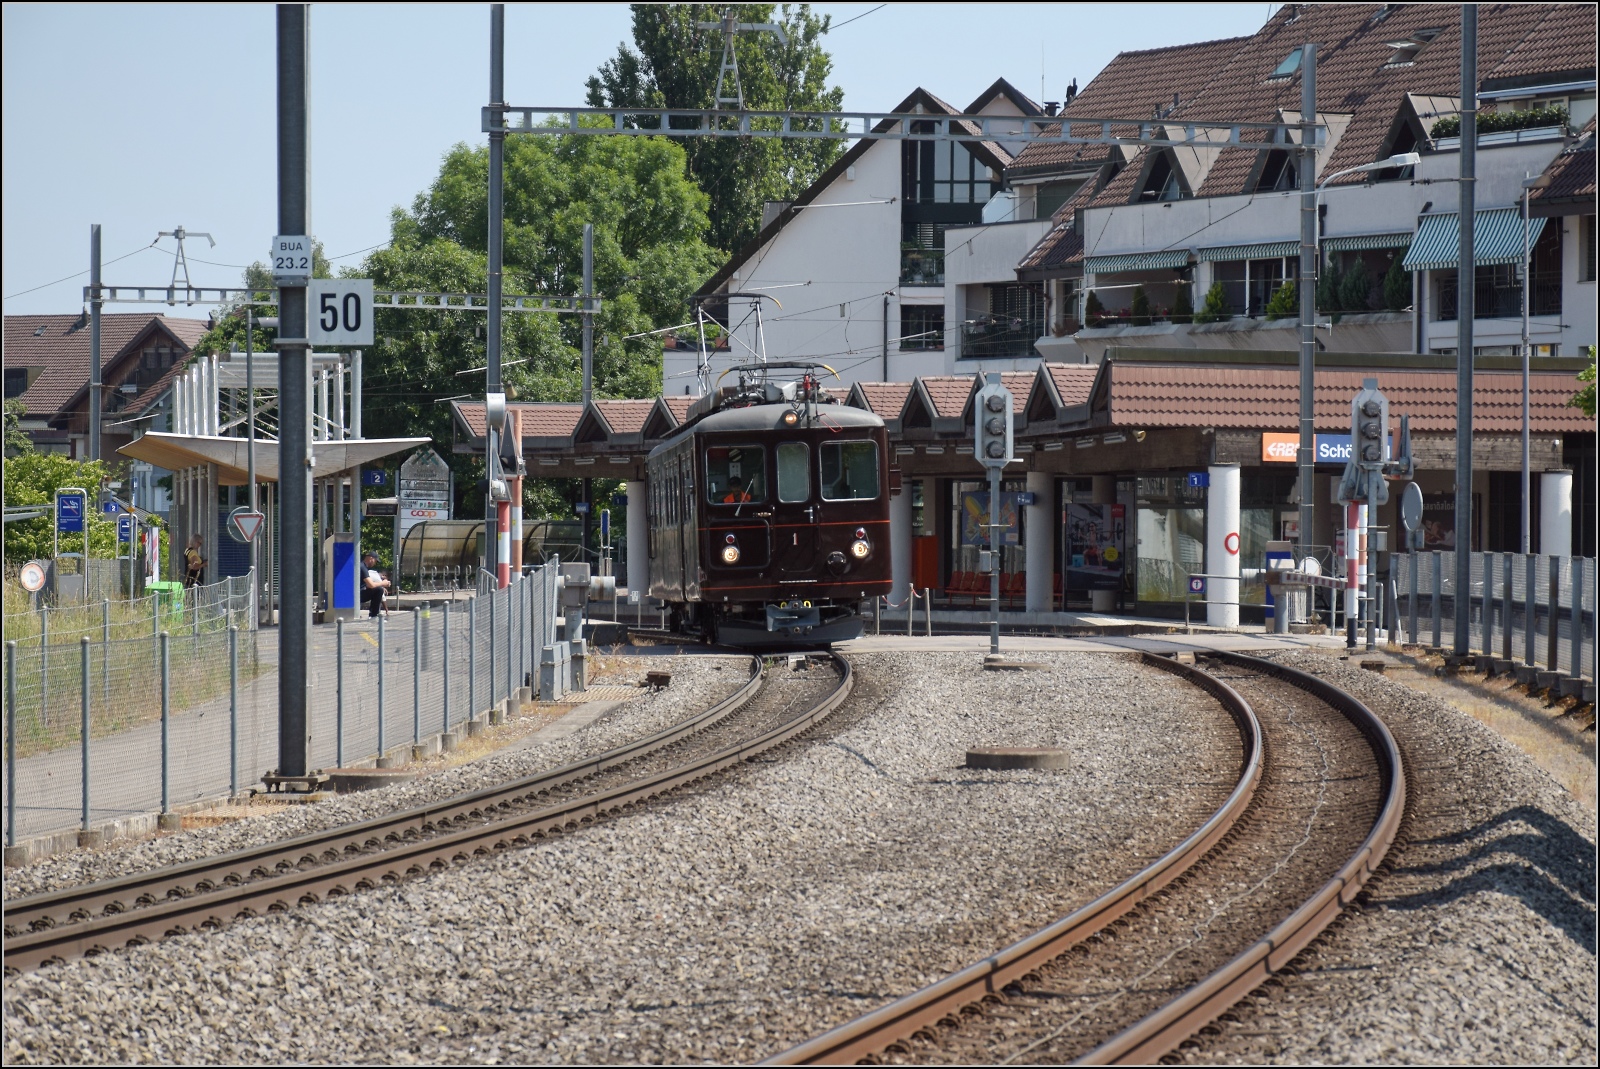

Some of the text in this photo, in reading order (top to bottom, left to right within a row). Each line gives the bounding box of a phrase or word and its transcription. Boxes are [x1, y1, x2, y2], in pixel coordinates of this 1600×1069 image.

[280, 242, 303, 251] BUA
[276, 257, 308, 269] 23.2
[320, 292, 362, 332] 50
[1319, 443, 1390, 459] Schöl
[374, 474, 381, 483] 2
[1192, 476, 1198, 485] 1
[410, 509, 437, 518] coop
[792, 532, 798, 546] 1
